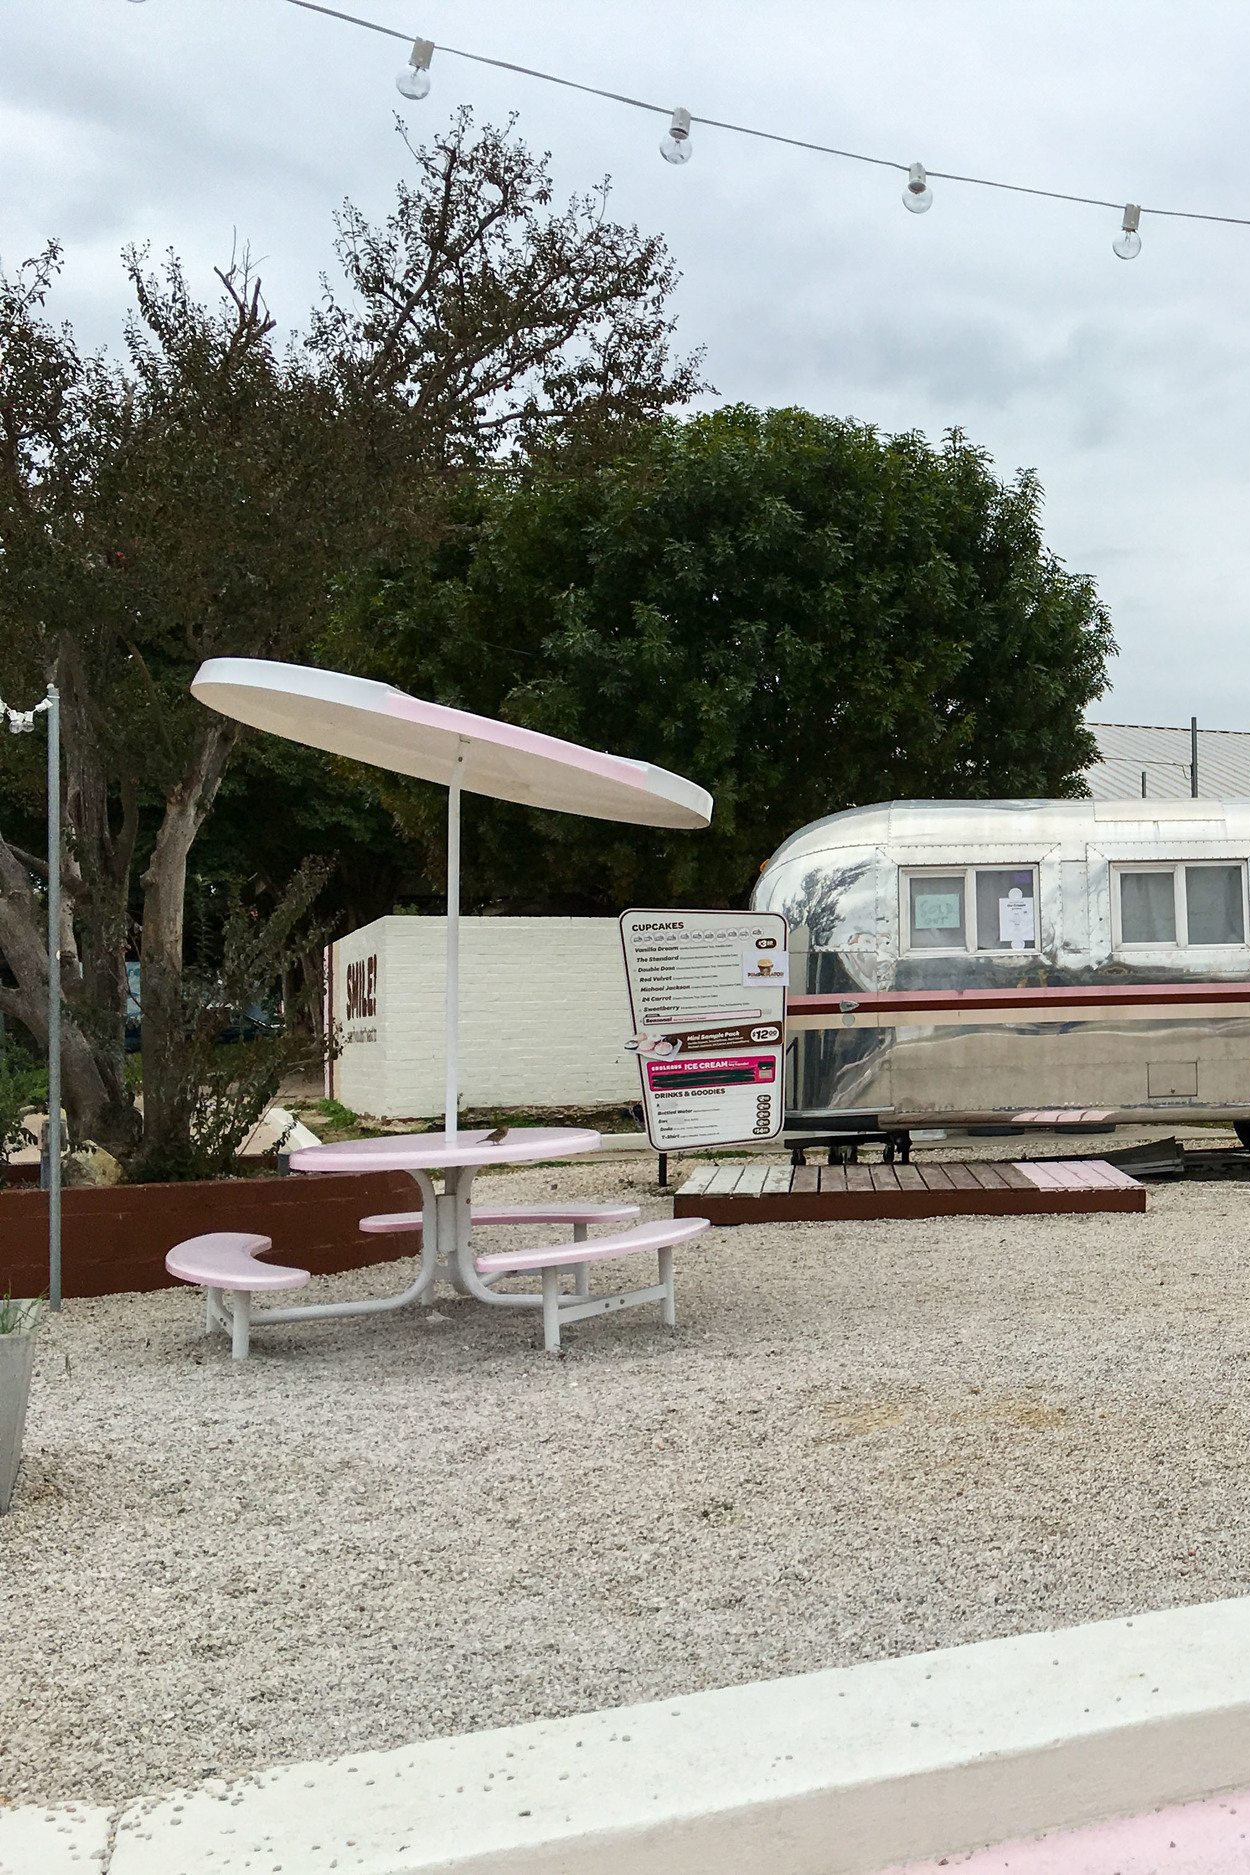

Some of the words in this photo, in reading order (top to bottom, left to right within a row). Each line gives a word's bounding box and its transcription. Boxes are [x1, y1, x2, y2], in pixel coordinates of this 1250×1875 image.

[632, 921, 685, 932] CUPCAKES
[346, 953, 378, 1022] SMILE!
[643, 1005, 680, 1013] Sweetberry
[700, 1032, 724, 1040] Sample
[724, 1030, 740, 1038] Pack
[684, 1063, 698, 1071] ICE
[698, 1061, 728, 1070] CREAM
[654, 1091, 684, 1099] DRINKS
[684, 1090, 690, 1098] &
[691, 1088, 726, 1096] GOODIES
